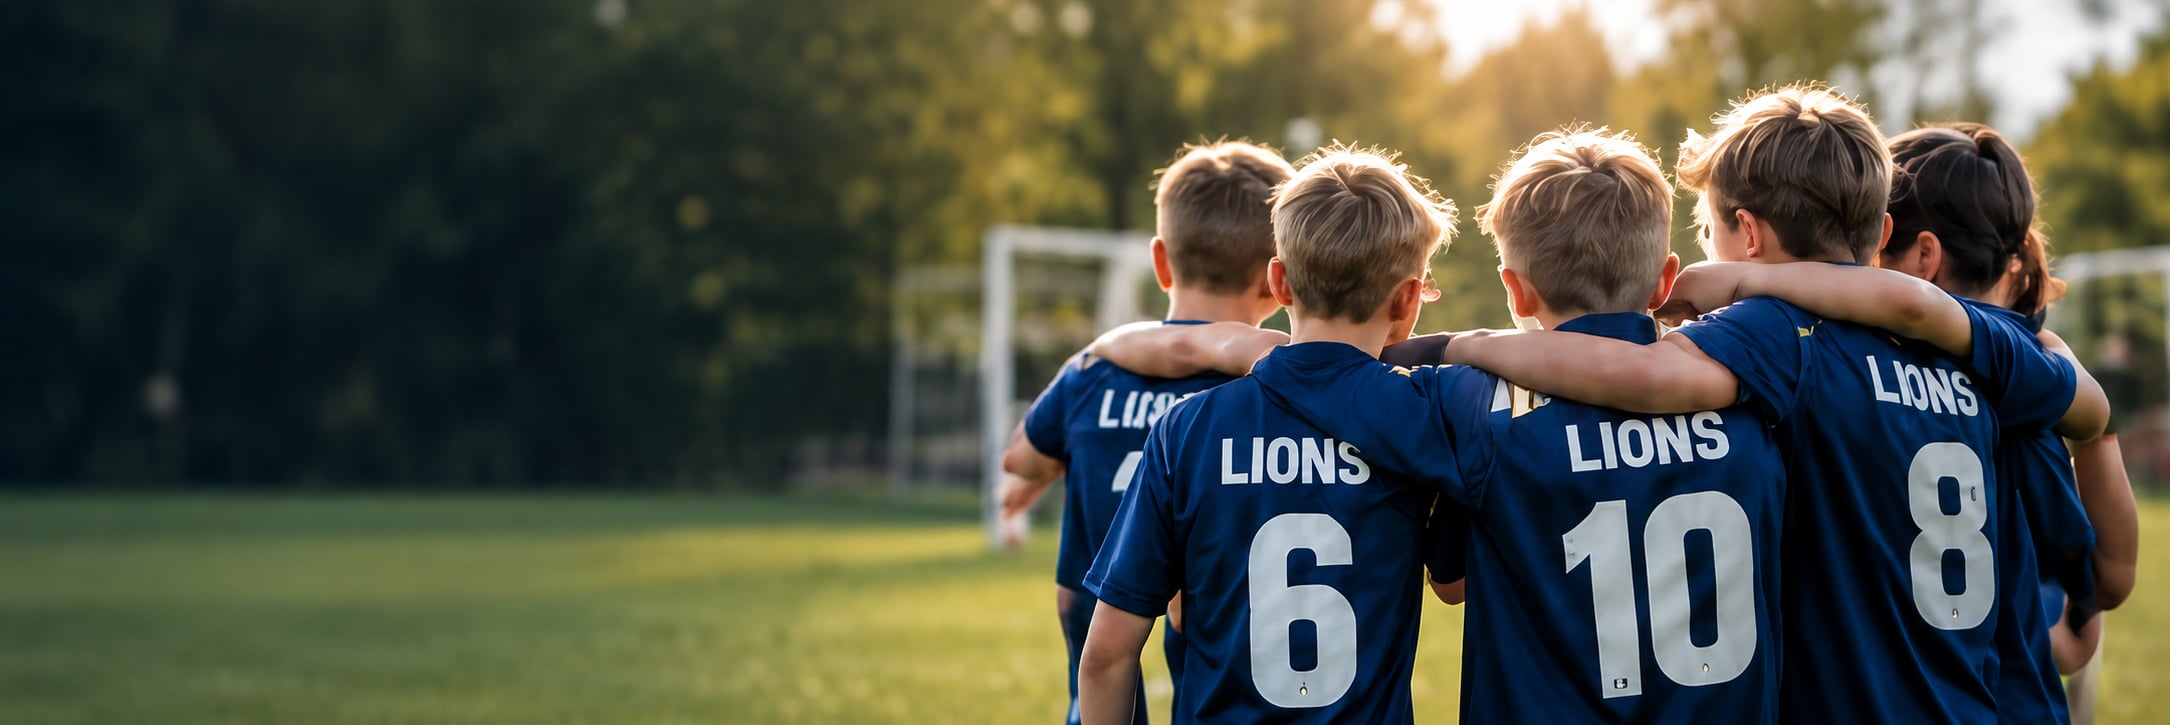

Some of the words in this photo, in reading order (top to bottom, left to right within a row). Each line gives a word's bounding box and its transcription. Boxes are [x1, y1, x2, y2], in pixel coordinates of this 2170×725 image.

[1565, 411, 1730, 473] LIONS
[1866, 355, 1979, 417] LIONS
[1221, 436, 1371, 485] LIONS
[1562, 490, 1757, 699] 10
[1908, 442, 1995, 630] 8
[1248, 513, 1357, 708] 6
